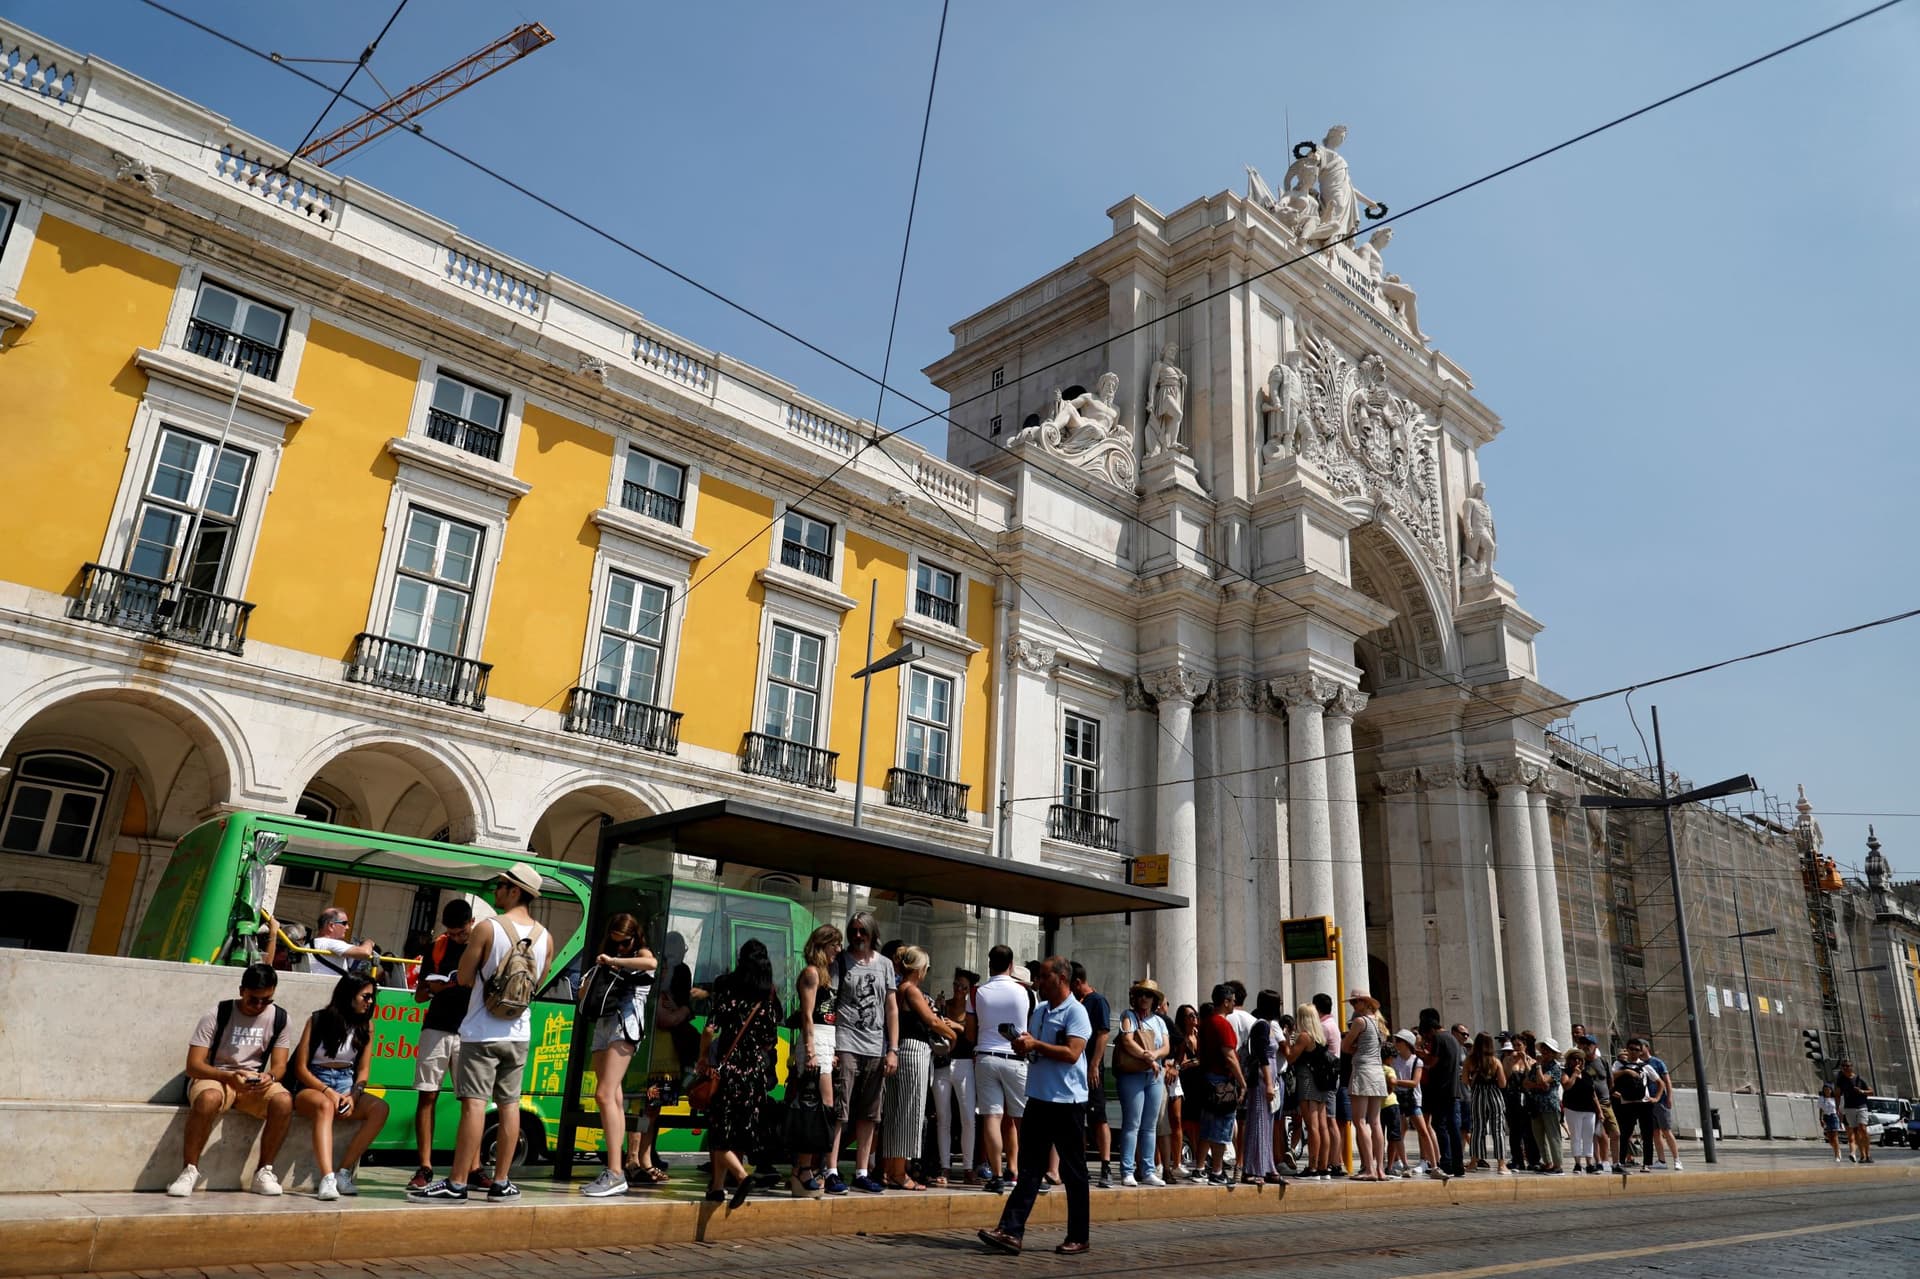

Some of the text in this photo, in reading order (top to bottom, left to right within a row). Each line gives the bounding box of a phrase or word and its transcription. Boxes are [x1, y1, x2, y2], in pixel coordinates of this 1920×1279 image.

[373, 1004, 428, 1022] ora
[233, 1026, 264, 1036] HATE
[231, 1036, 262, 1046] LATE
[371, 1034, 419, 1058] isb
